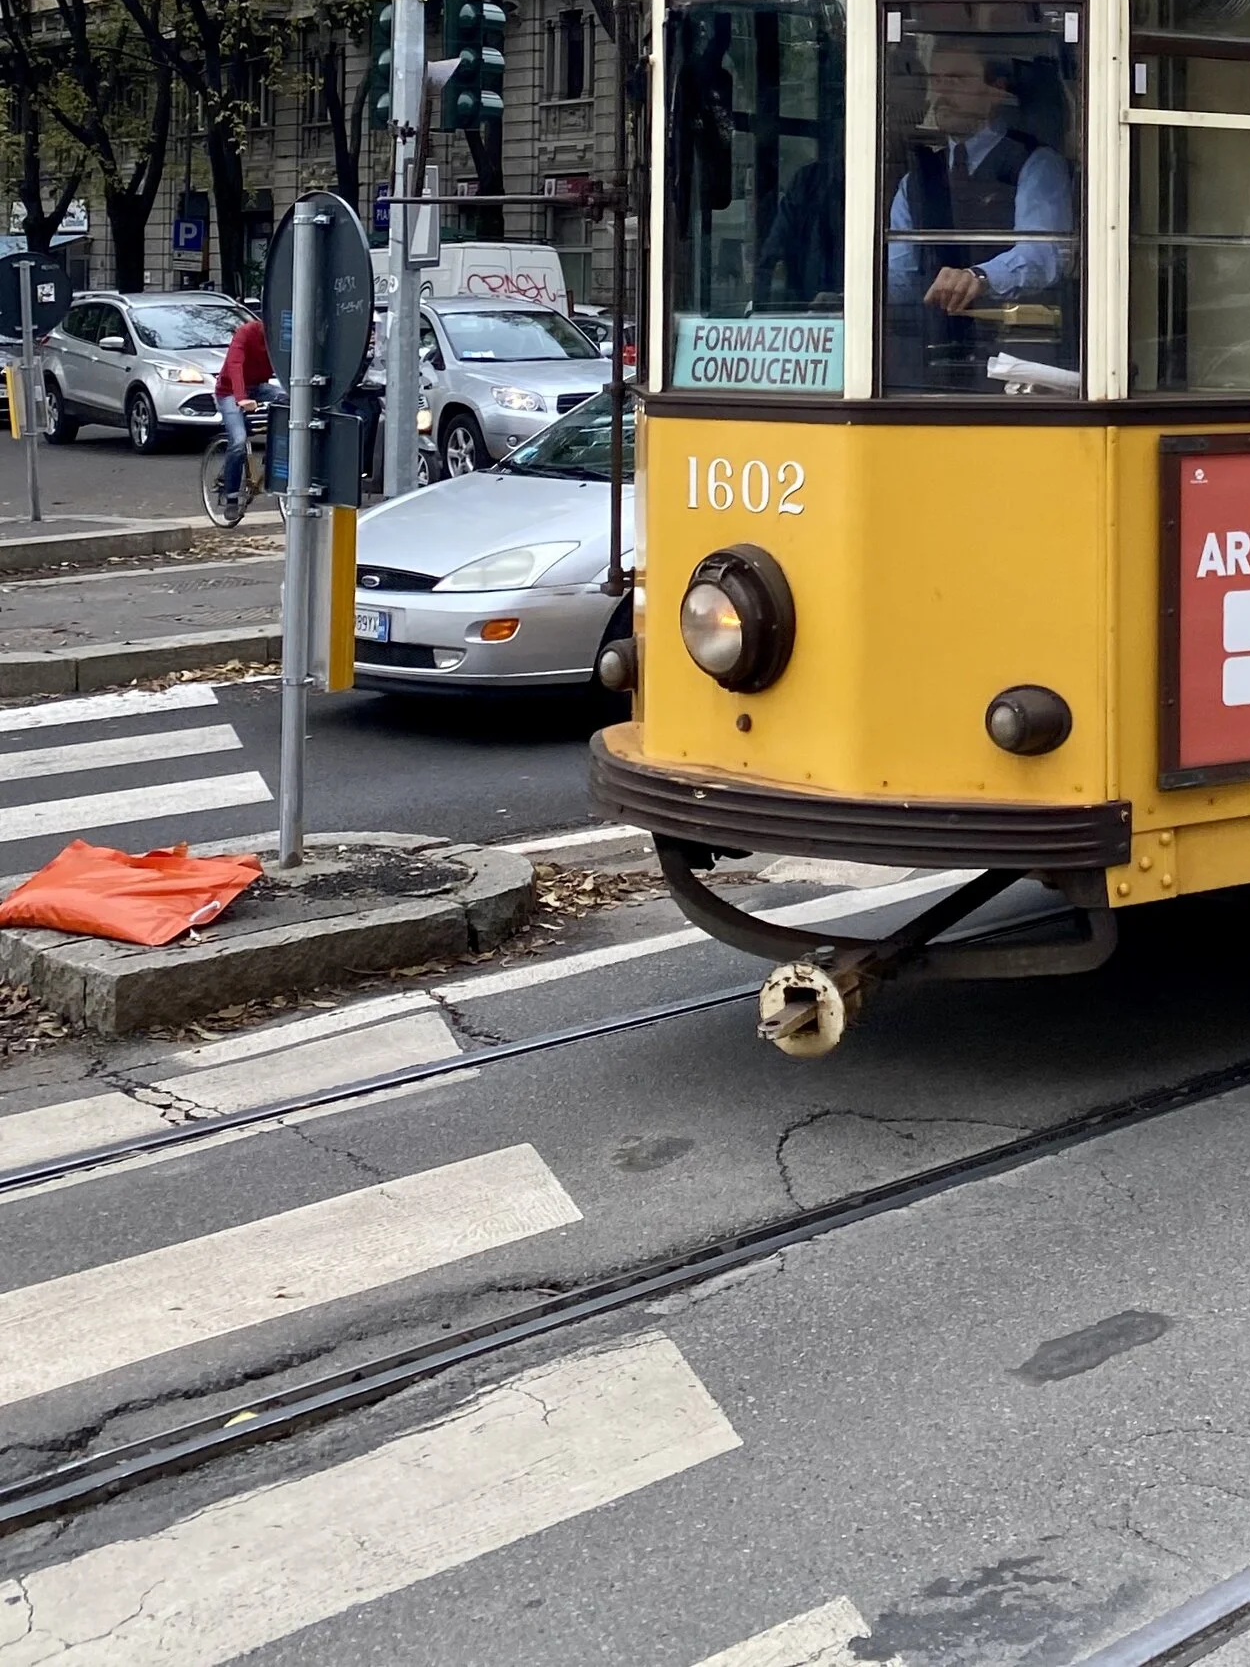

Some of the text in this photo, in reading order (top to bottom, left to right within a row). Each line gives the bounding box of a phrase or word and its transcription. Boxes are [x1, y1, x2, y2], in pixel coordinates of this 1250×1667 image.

[179, 222, 197, 246] P
[692, 325, 834, 354] FORMAZIONE
[691, 356, 829, 386] CONDUCENTI
[688, 456, 806, 516] 1602
